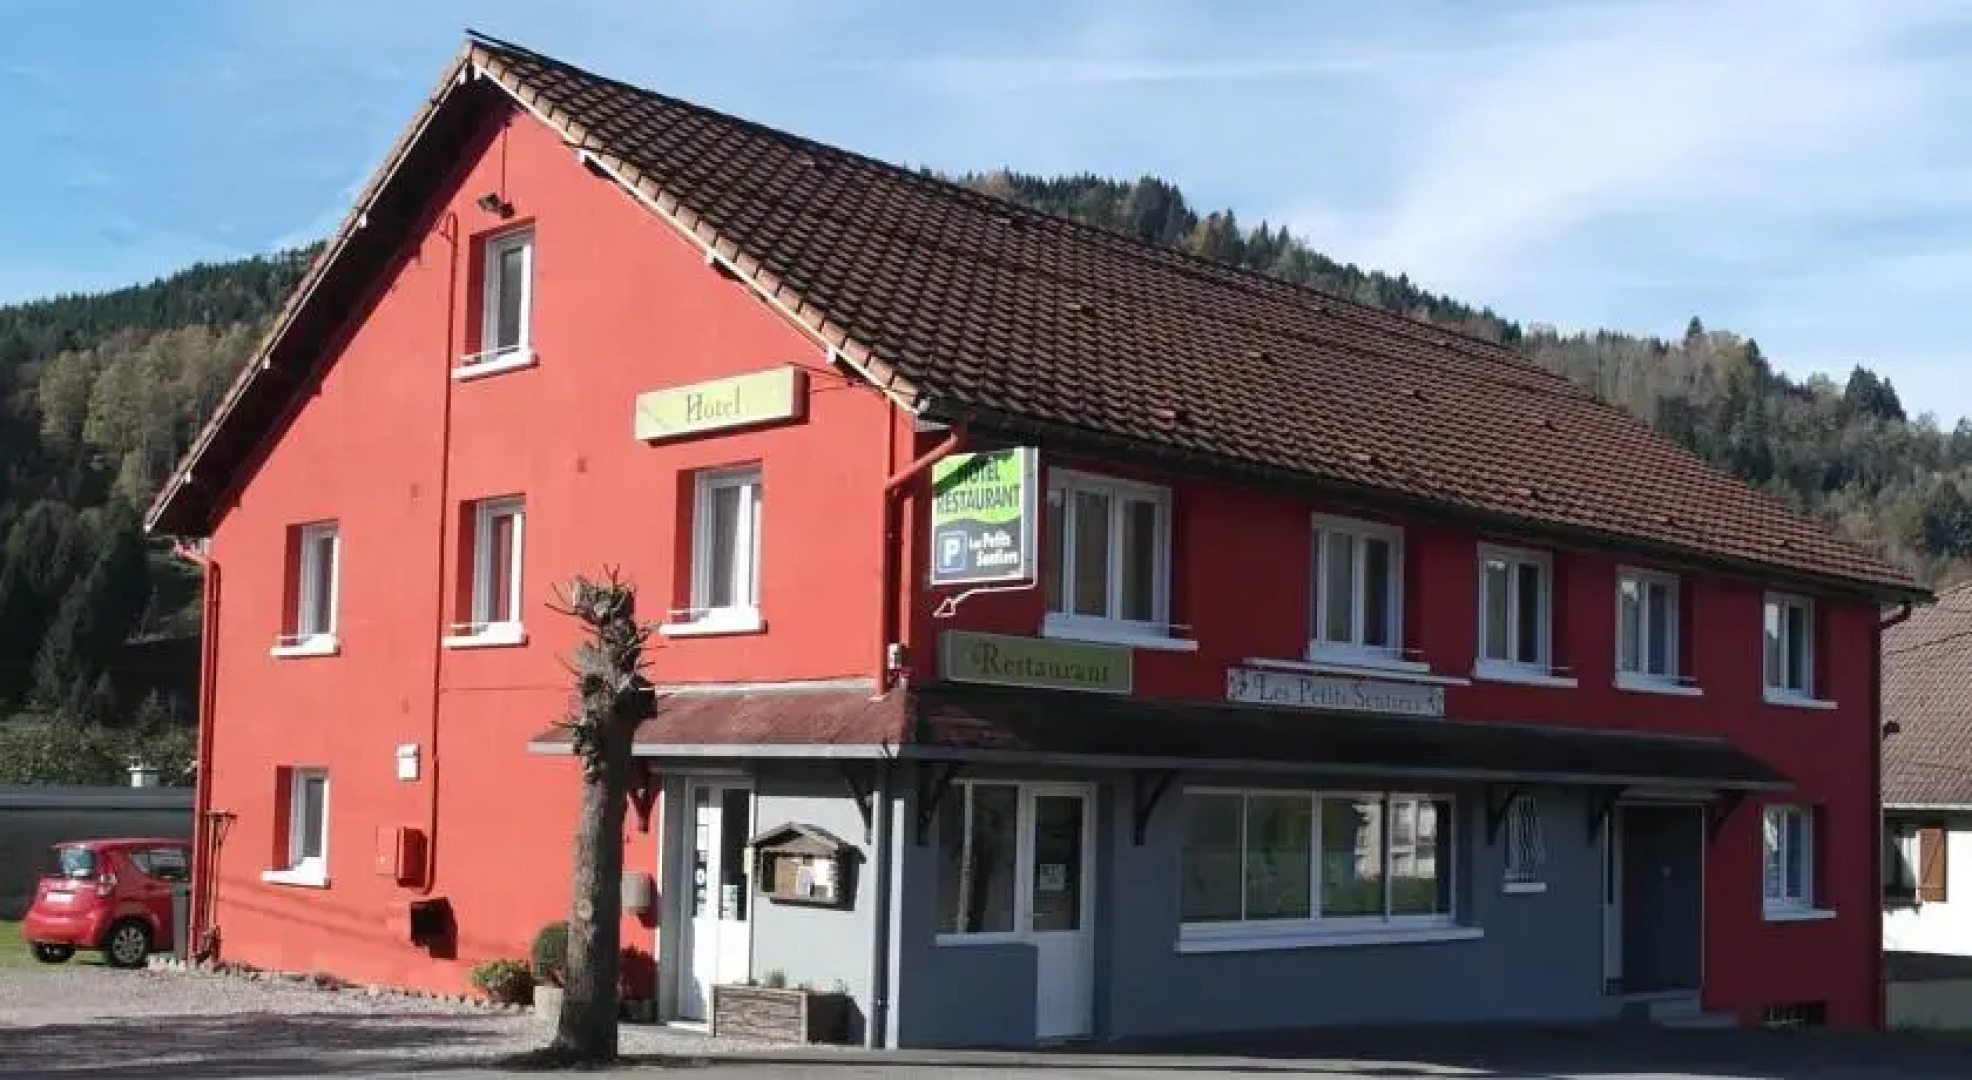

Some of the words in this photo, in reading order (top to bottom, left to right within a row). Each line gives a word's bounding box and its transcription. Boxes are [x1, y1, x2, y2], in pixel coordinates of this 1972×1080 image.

[685, 384, 740, 424] Hotel
[936, 484, 1021, 514] RESTAURANT
[970, 640, 1110, 684] Restaurant
[1252, 673, 1291, 701] Les
[1298, 677, 1346, 706] Petits
[1350, 681, 1421, 712] Sentiers
